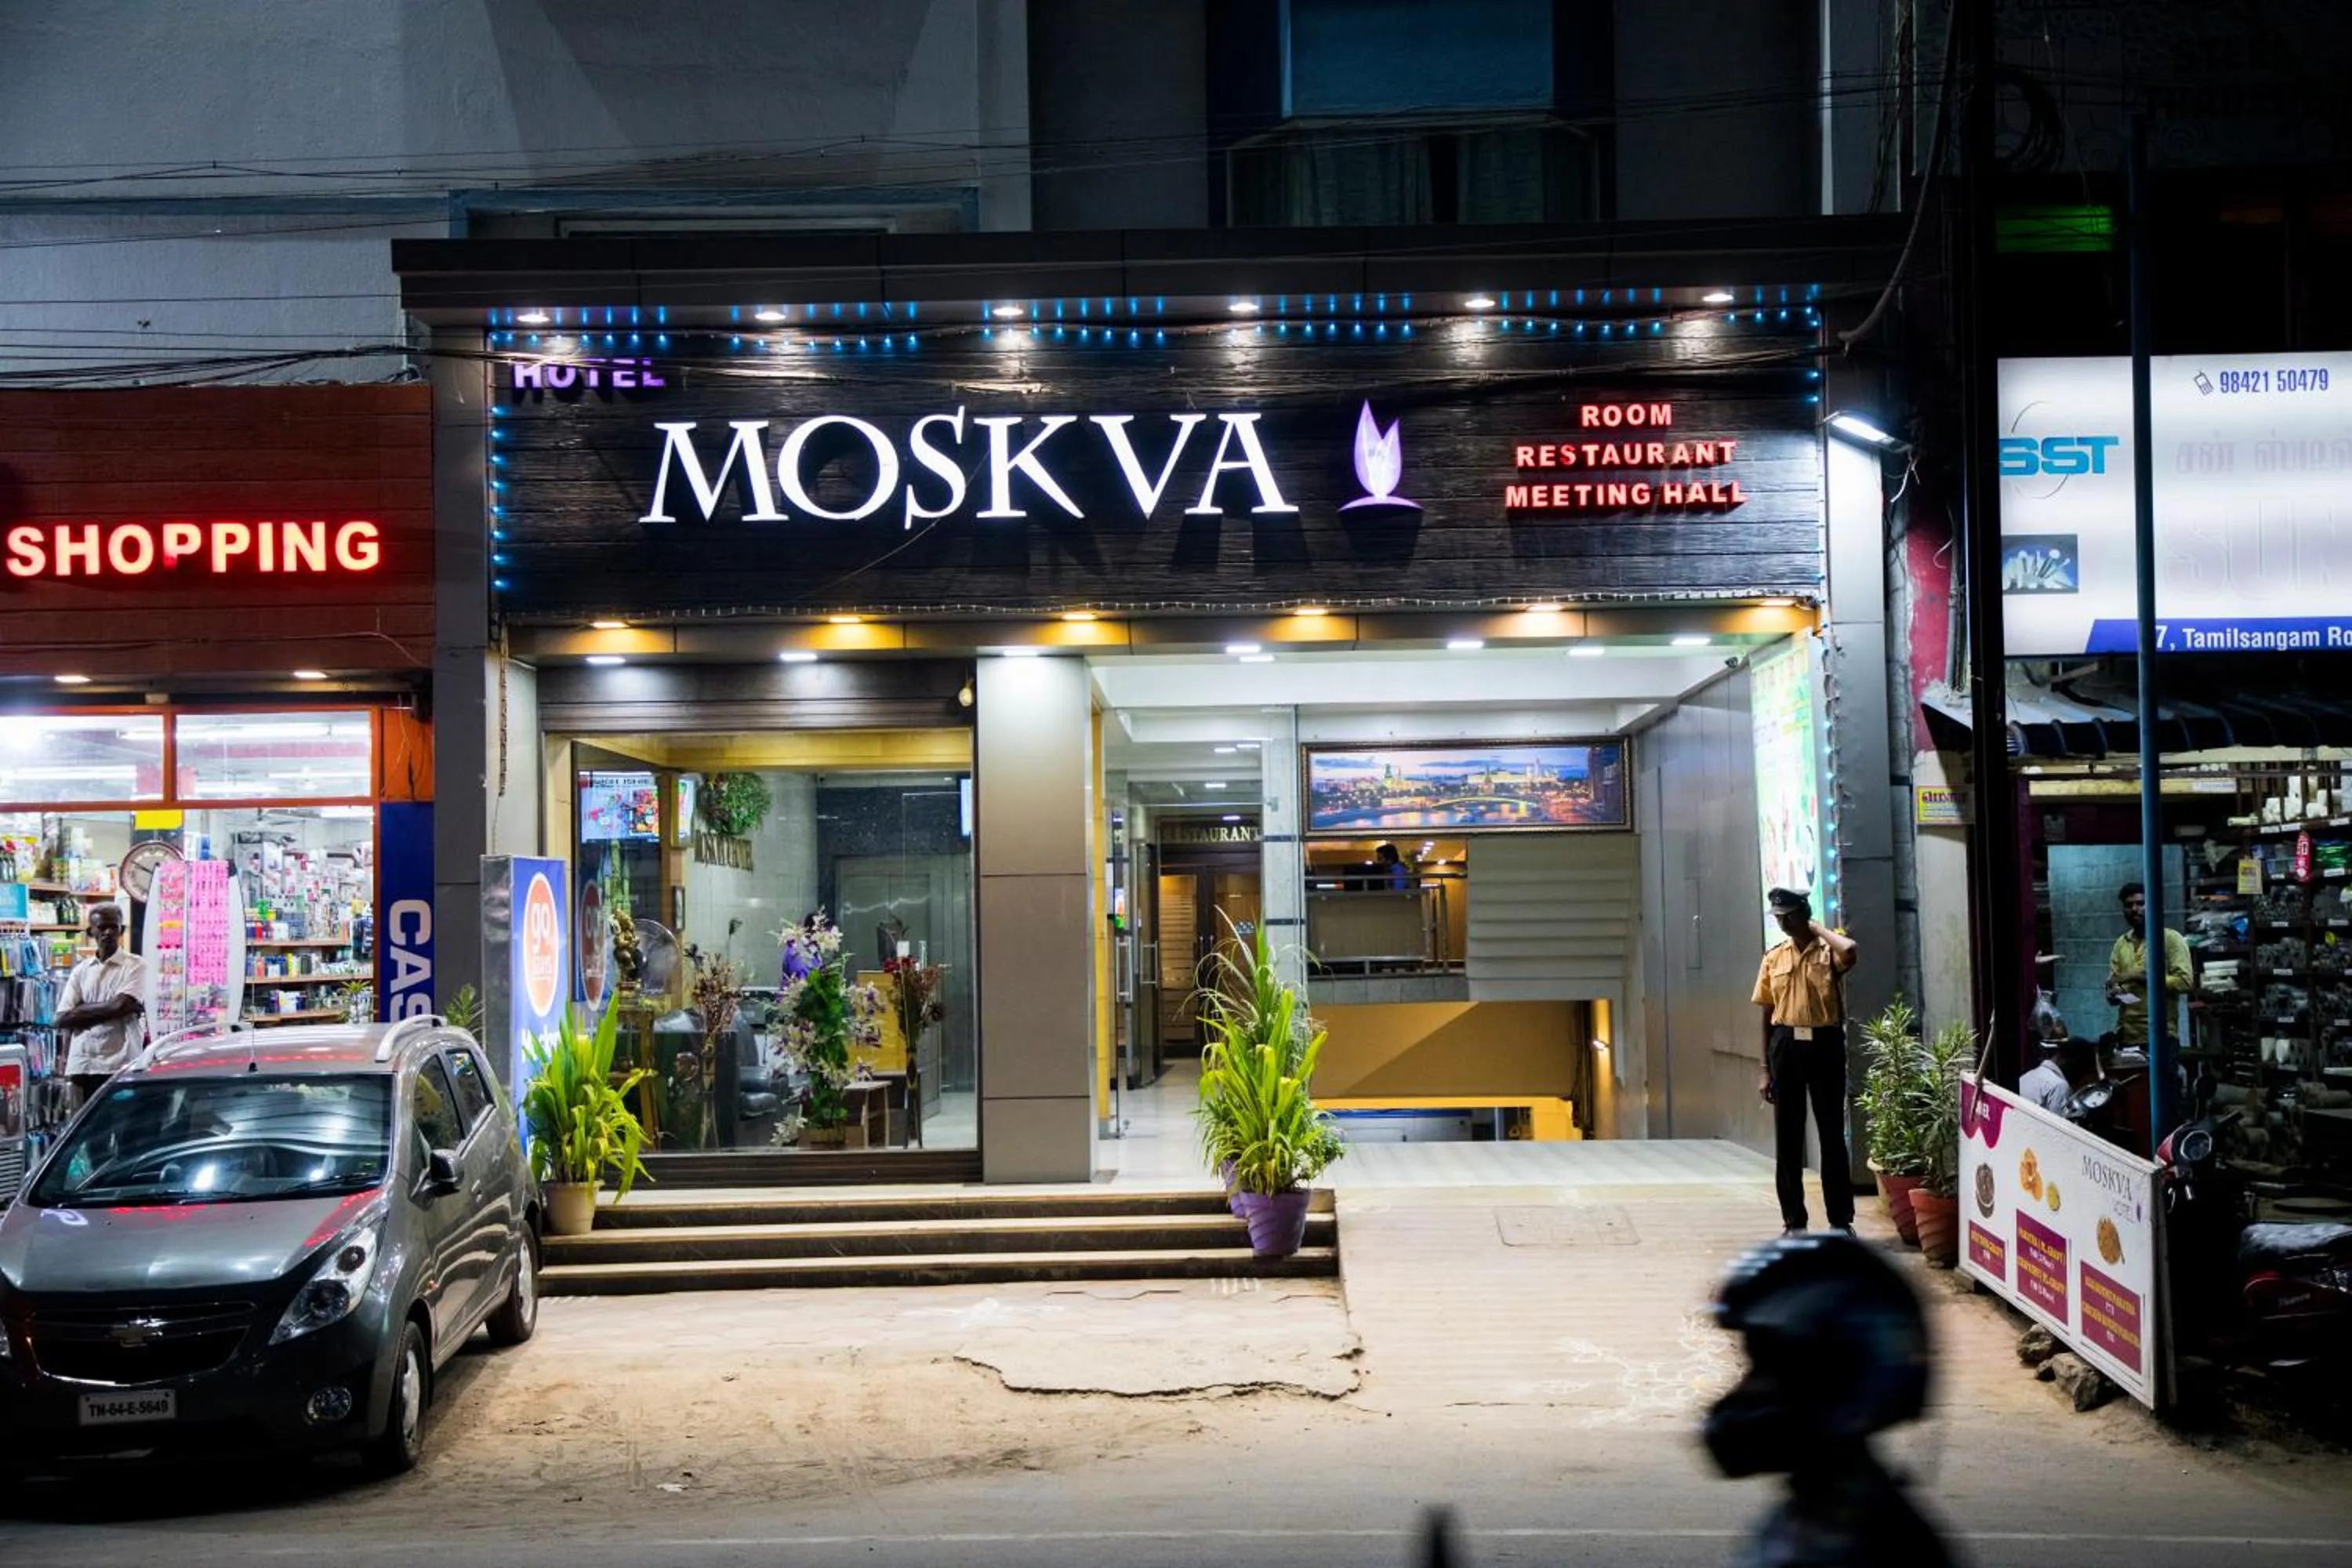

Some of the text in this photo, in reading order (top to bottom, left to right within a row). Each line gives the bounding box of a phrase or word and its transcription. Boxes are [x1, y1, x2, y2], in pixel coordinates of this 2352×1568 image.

[514, 358, 666, 388] HOTEL
[2220, 368, 2329, 394] 98421 50479
[1581, 404, 1672, 427] ROOM
[639, 405, 1298, 529] MOSKVA
[1515, 441, 1737, 468] RESTAURANT
[1998, 435, 2120, 476] SST
[1504, 481, 1749, 508] MEETING HALL
[5, 521, 382, 577] SHOPPING
[2183, 627, 2321, 651] Tamilsangam
[2082, 1155, 2132, 1201] MOSKVA
